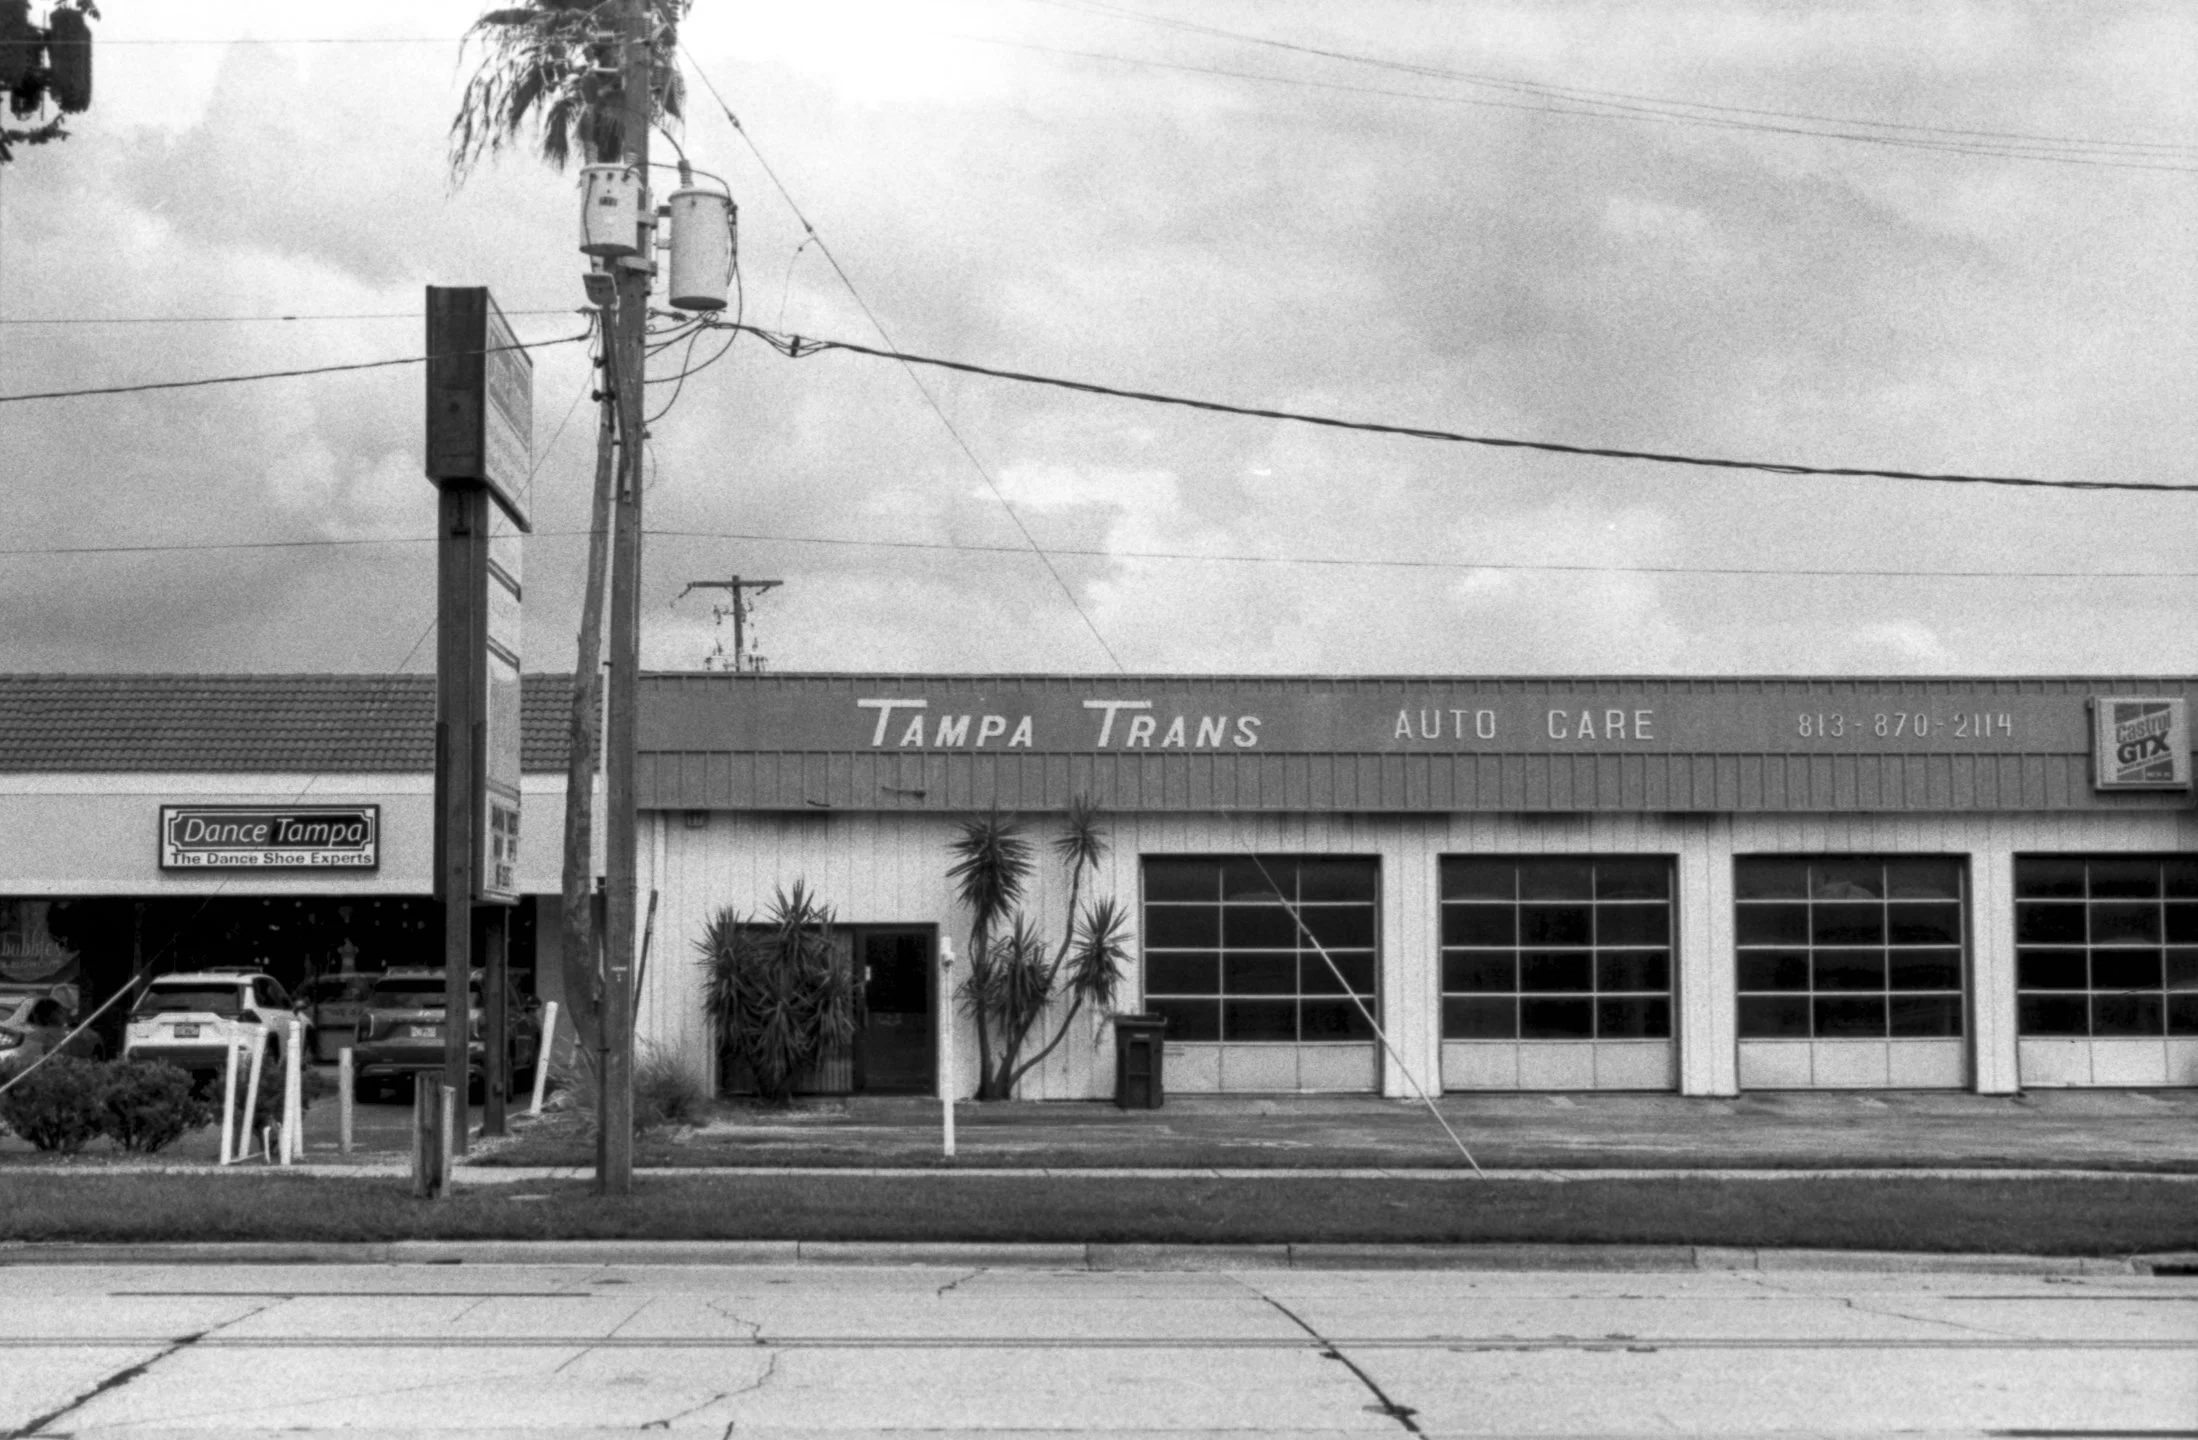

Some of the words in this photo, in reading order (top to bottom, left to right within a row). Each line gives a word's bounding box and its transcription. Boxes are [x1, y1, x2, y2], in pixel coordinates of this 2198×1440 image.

[857, 699, 1033, 748] TAMPA
[1083, 700, 1262, 748] TRANS
[1394, 709, 1496, 739] AUTO
[1547, 709, 1654, 739] CARE
[2117, 731, 2170, 764] GTX
[183, 818, 268, 842] Dance
[276, 817, 363, 847] Tampa
[171, 852, 201, 865] The
[206, 852, 258, 865] Dance
[263, 852, 305, 865] Shoe
[311, 852, 373, 867] Experts
